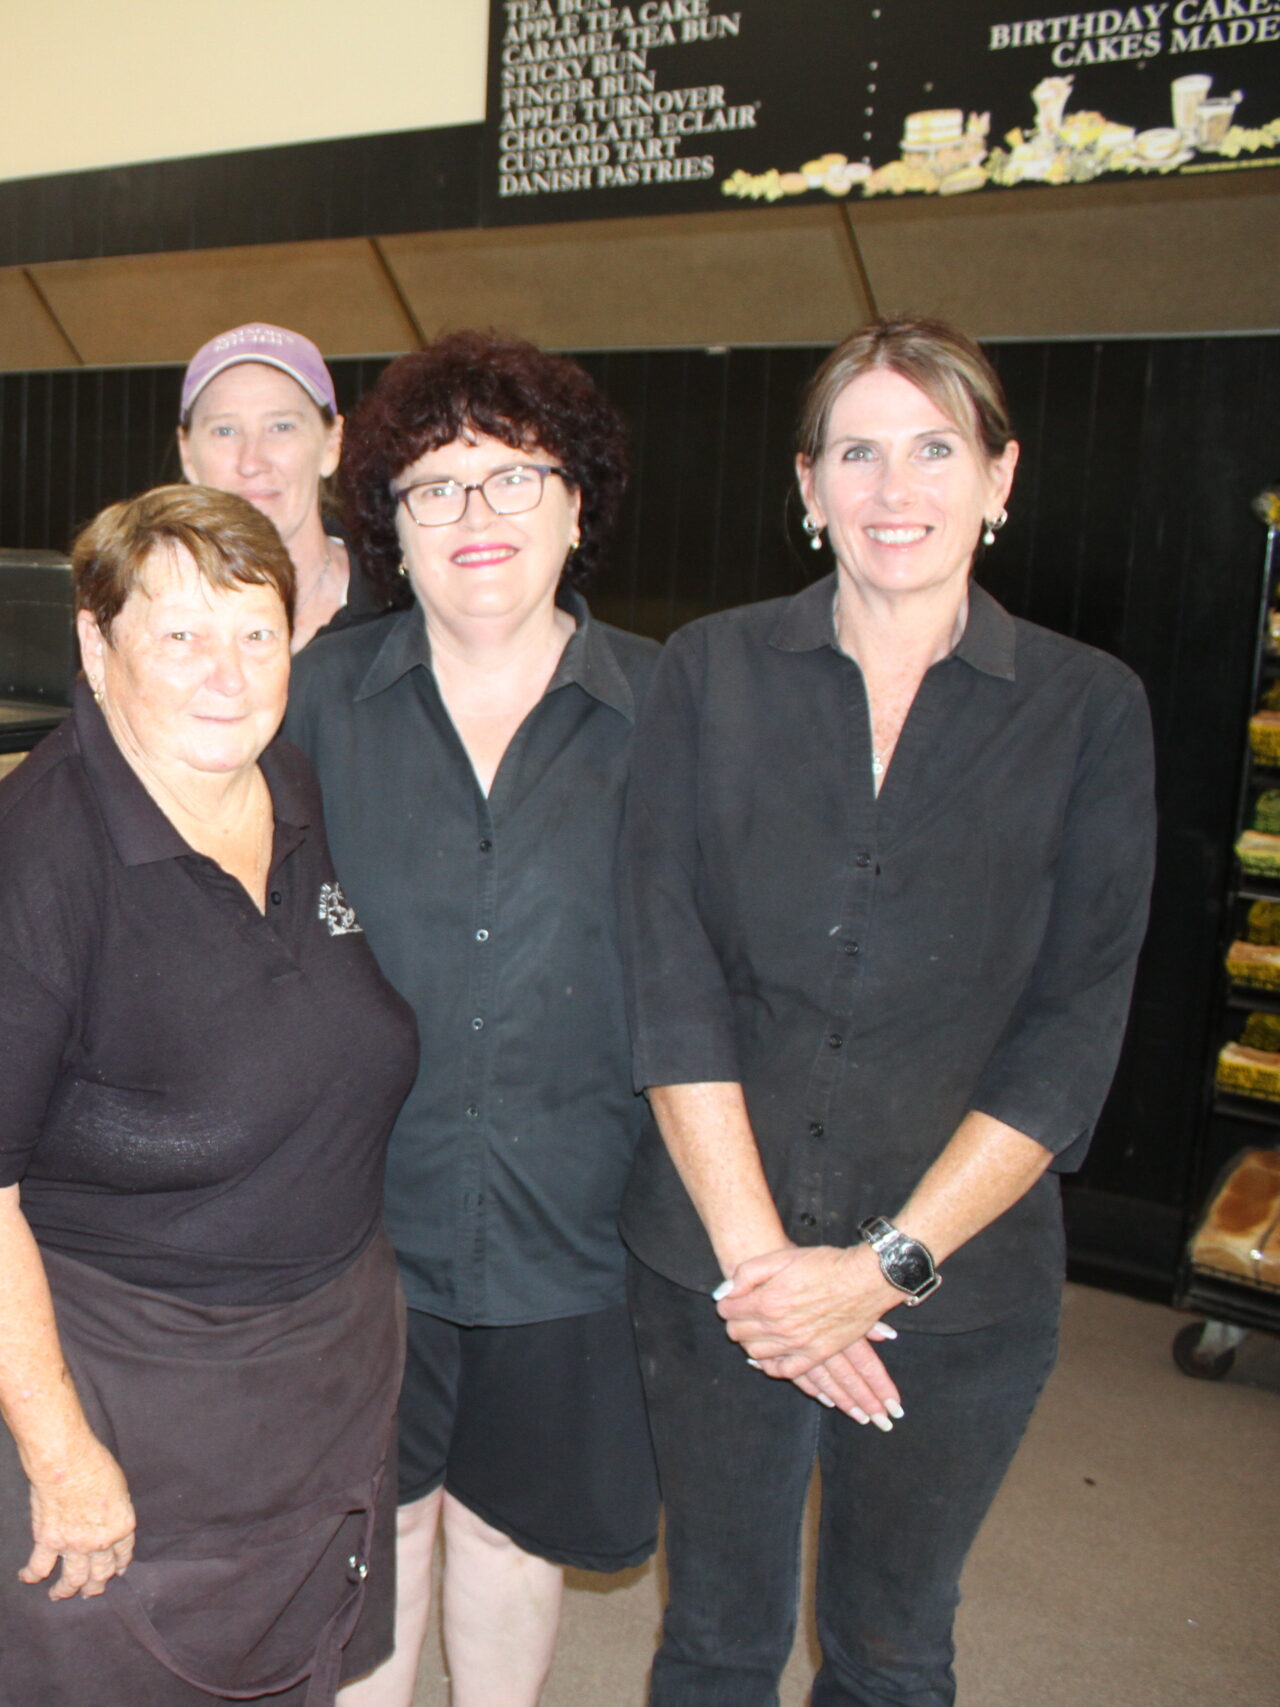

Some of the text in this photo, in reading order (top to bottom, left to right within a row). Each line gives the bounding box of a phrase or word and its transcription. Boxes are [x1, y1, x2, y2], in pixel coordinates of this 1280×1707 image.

[503, 0, 553, 22] TEA
[503, 0, 709, 45] APPLE TEA CAKE
[988, 3, 1169, 51] BIRTHDAY
[502, 12, 741, 67] CARAMEL TEA BUN
[1051, 14, 1280, 67] CAKES MADE
[501, 49, 648, 88] STICKY BUN
[501, 70, 656, 110] FINGER BUN
[499, 104, 758, 152] CHOCOLATE ECLAIR
[500, 84, 725, 131] APPLE TURNOVER
[498, 155, 715, 197] DANISH PASTRIES
[499, 135, 681, 175] CUSTARD TART
